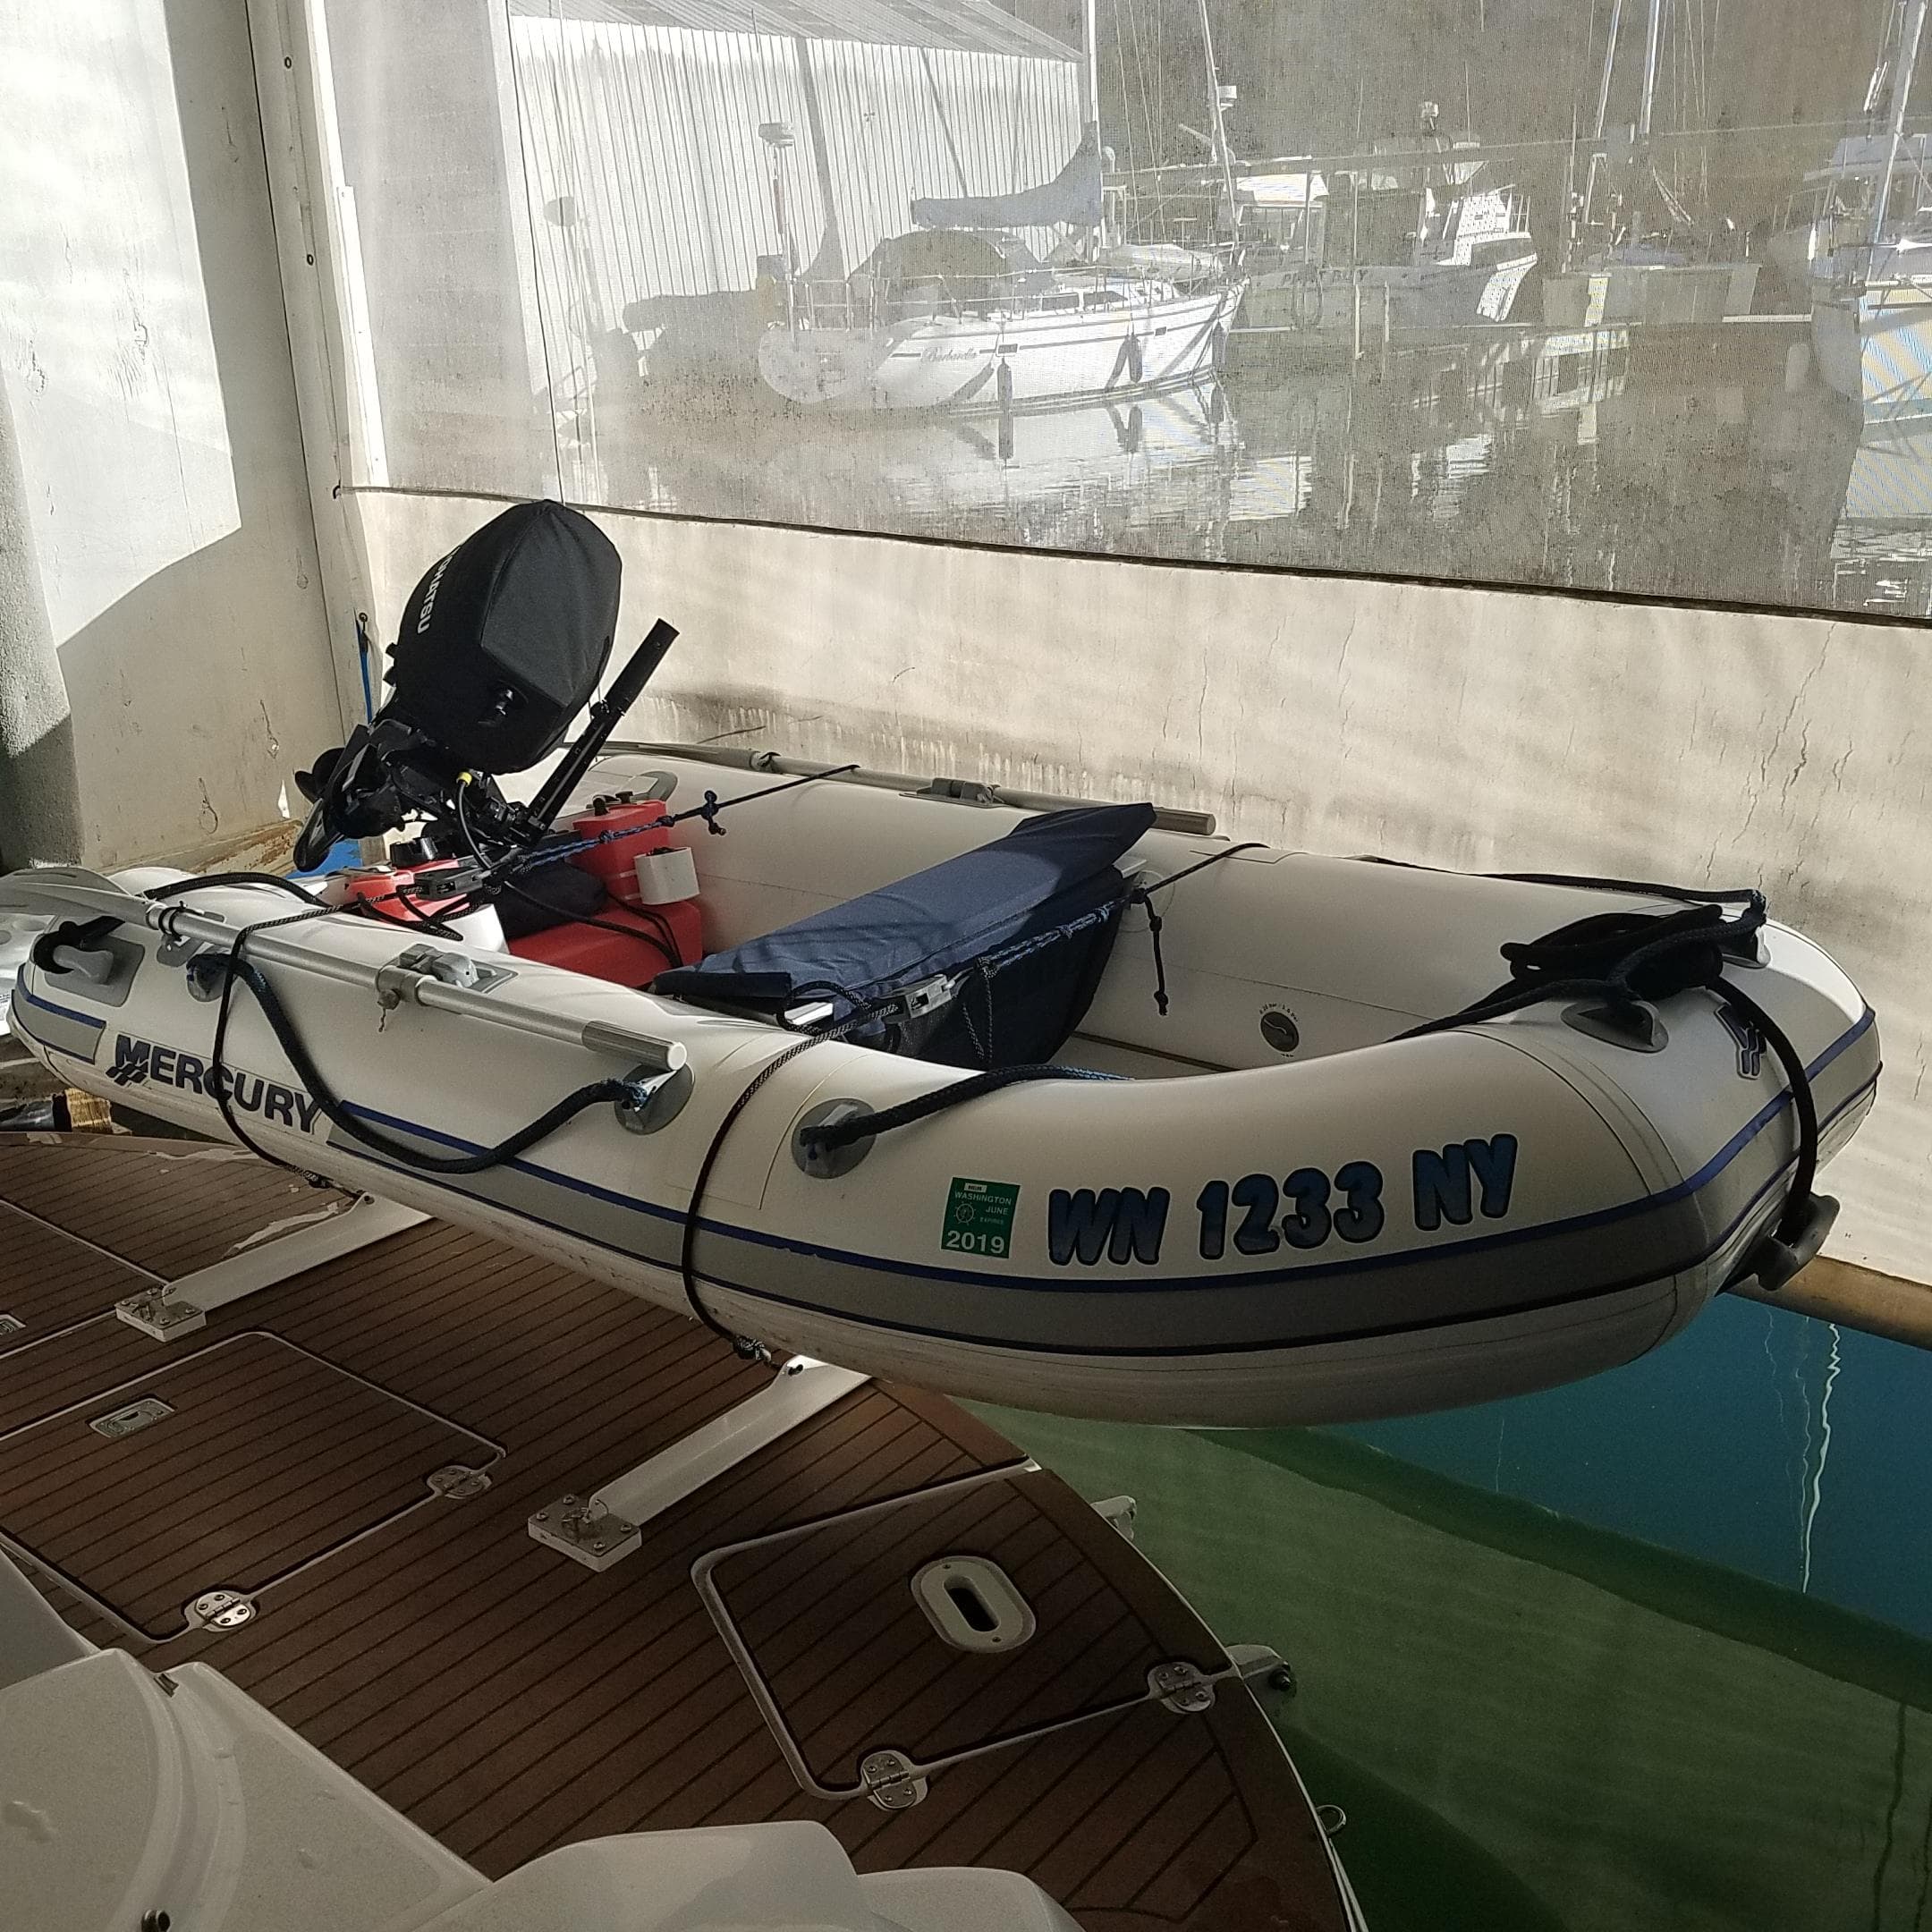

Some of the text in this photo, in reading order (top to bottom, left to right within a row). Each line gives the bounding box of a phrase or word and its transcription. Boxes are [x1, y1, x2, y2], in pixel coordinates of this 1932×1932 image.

[106, 1034, 321, 1133] MERCURY
[955, 1191, 1012, 1205] WASHINGTON
[1047, 1132, 1519, 1267] WN 1233 NY
[986, 1206, 1009, 1216] JUNE
[945, 1230, 1005, 1254] 2019
